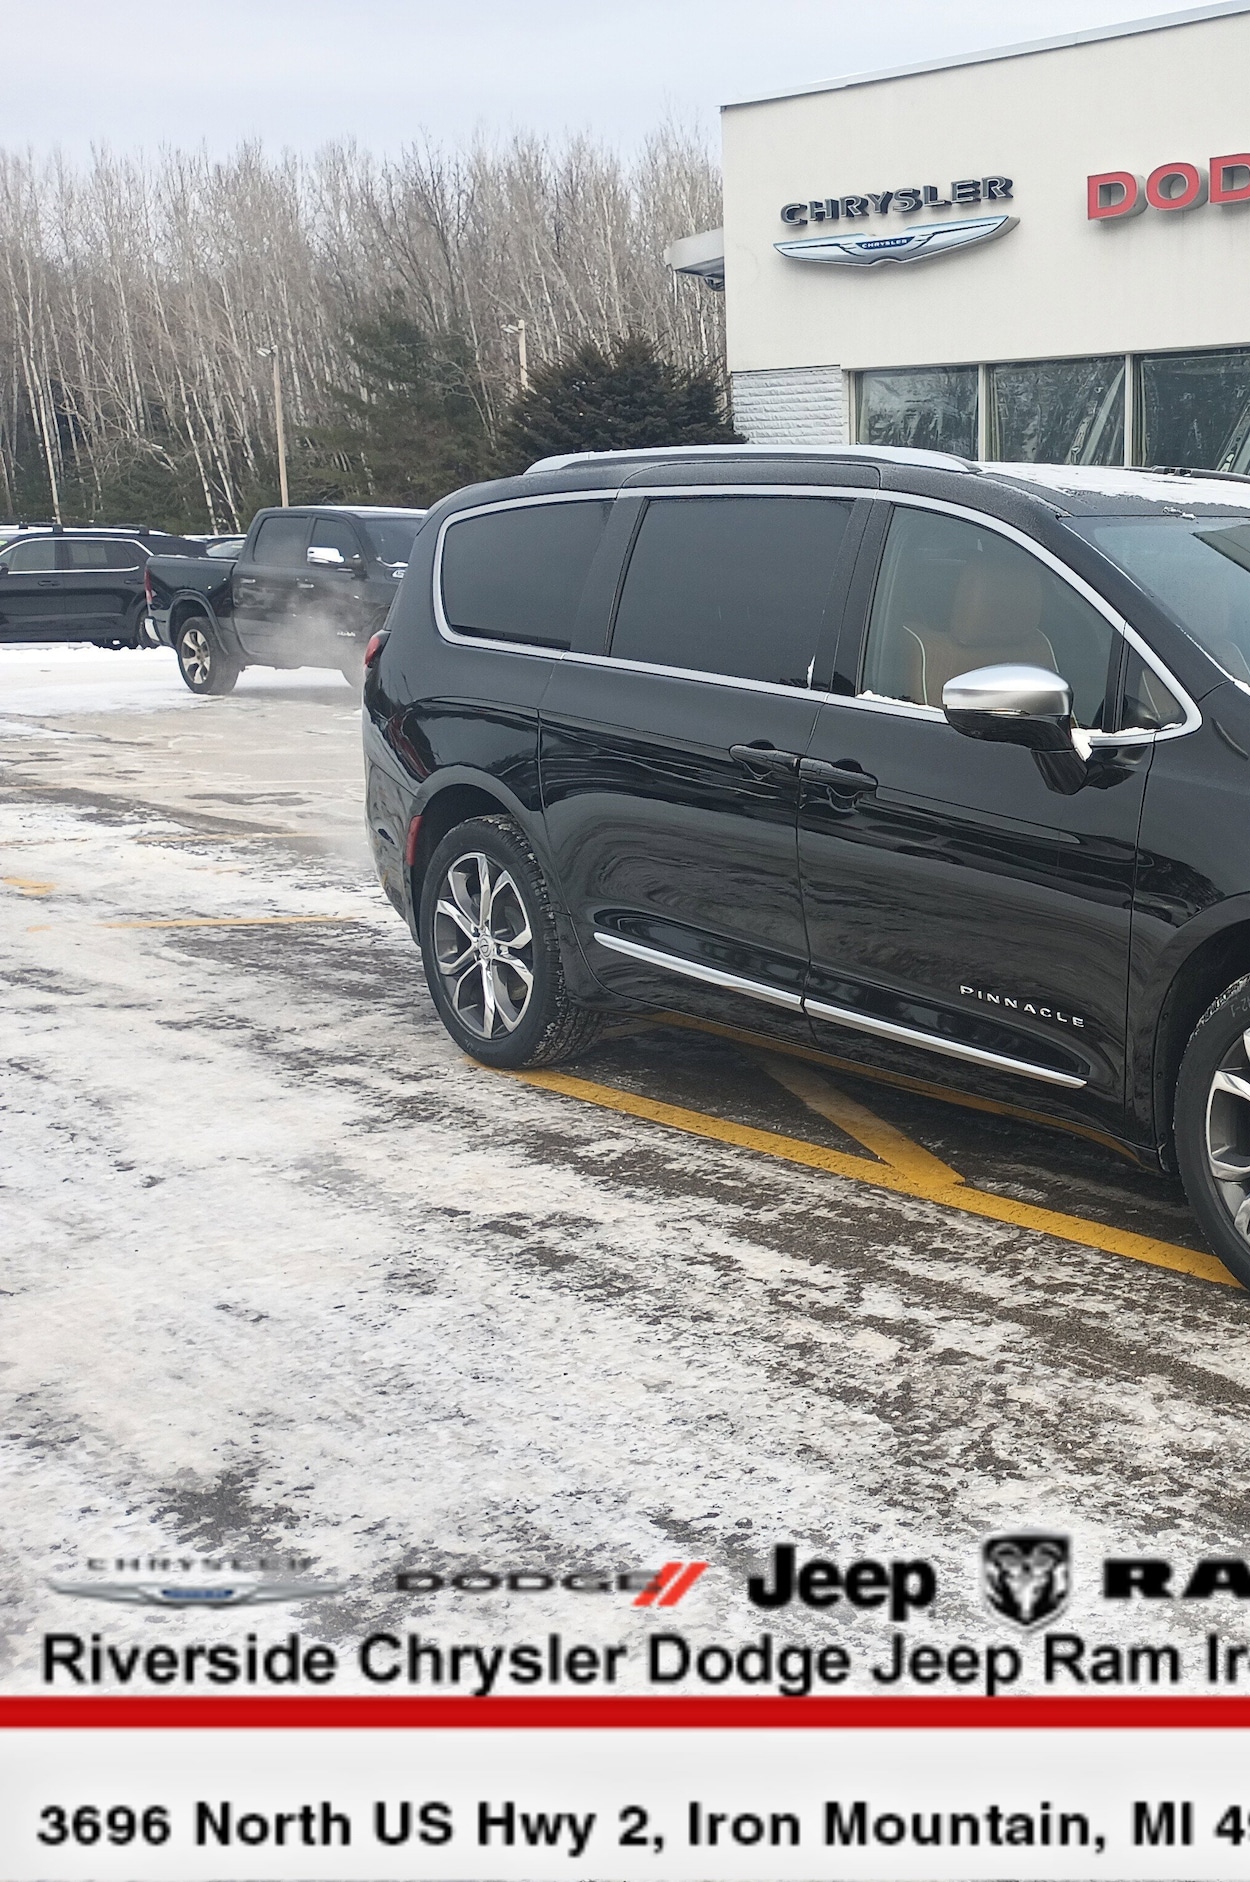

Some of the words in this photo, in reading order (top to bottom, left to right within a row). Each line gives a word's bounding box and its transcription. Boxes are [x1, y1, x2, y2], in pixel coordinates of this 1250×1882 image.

[780, 175, 1014, 226] CHRYSLER
[861, 238, 908, 249] CHRYSLER
[959, 984, 1086, 1028] PINNACLE
